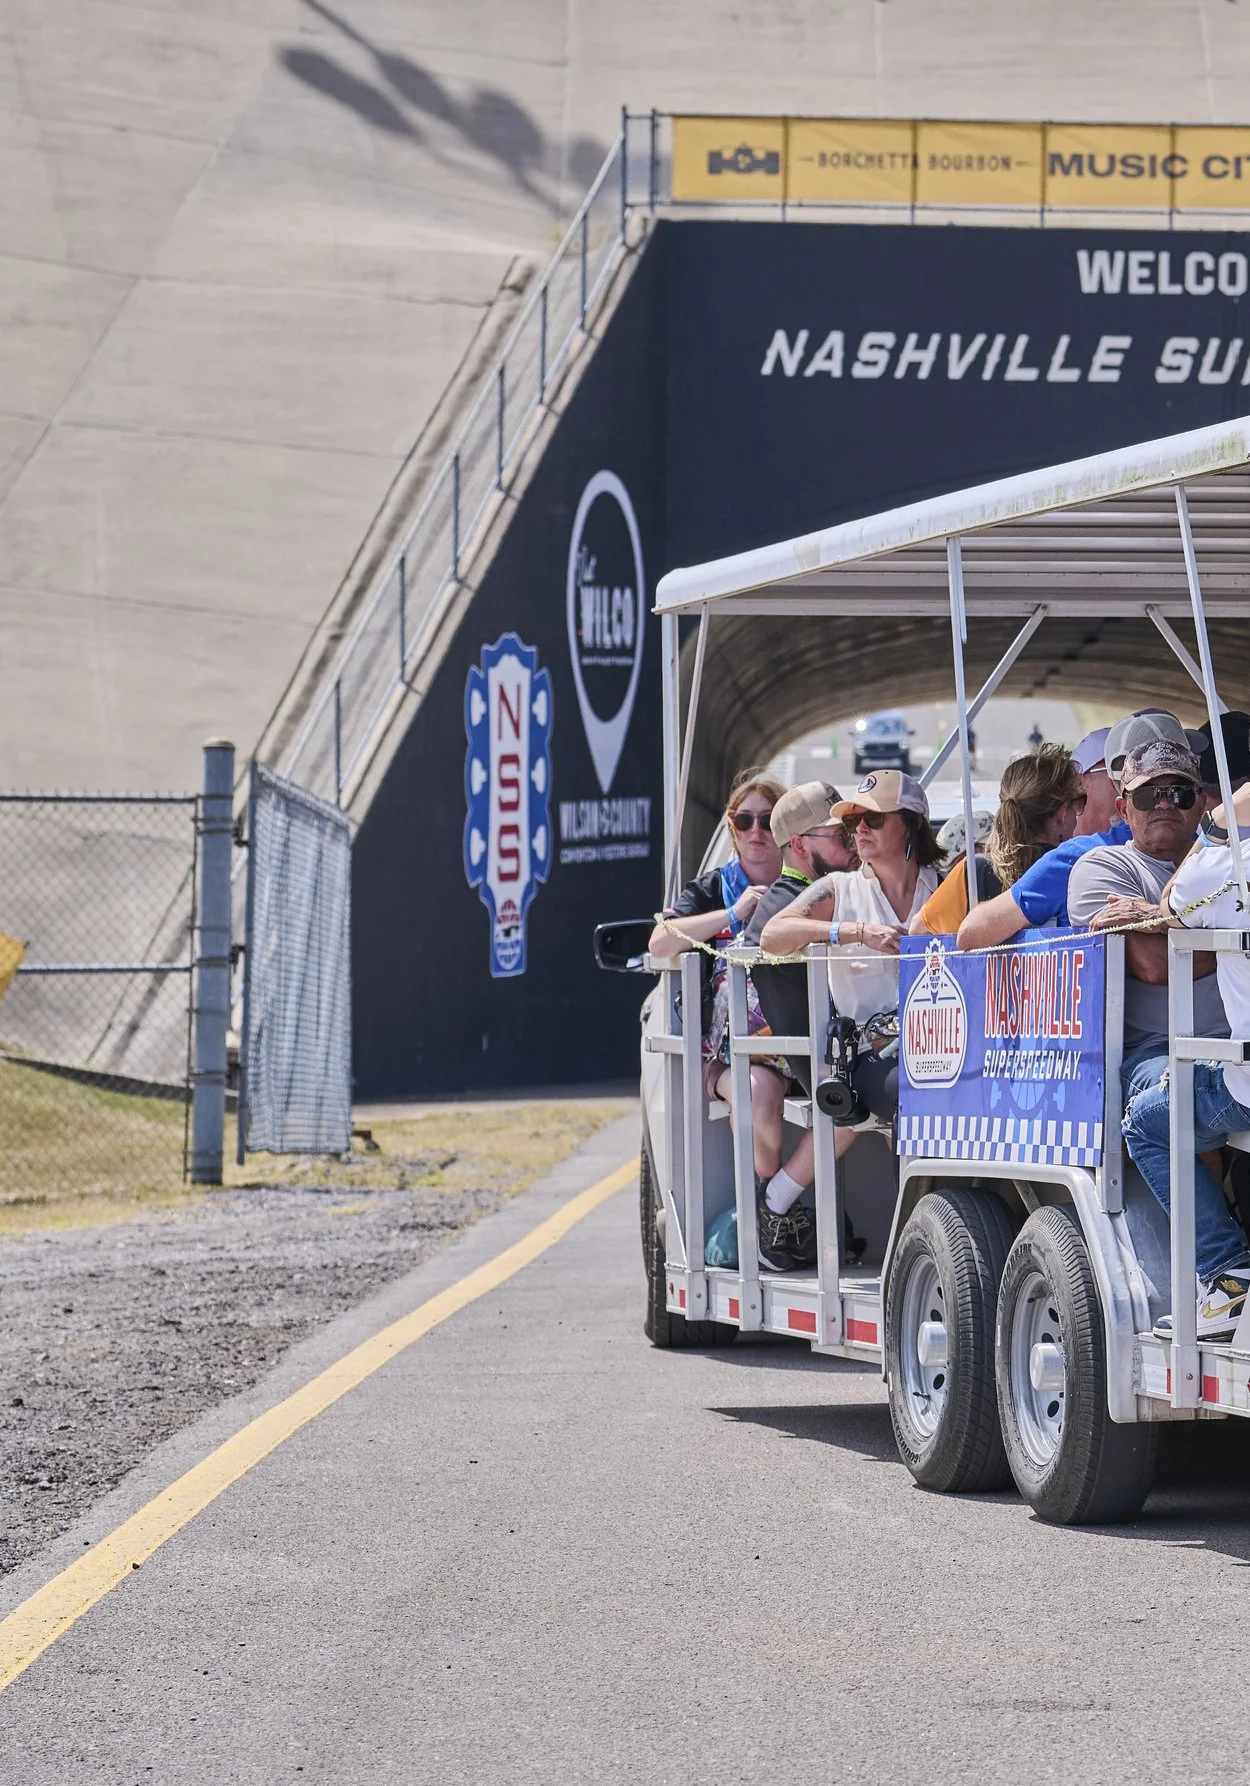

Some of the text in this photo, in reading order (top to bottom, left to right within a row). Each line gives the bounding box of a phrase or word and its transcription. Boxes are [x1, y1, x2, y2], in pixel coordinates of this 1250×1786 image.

[817, 151, 1013, 172] BORCHETTA BOURBON
[1047, 153, 1188, 180] MUSIC
[761, 329, 1132, 382] NASHVILLE
[580, 586, 634, 649] WILCO
[983, 950, 1084, 1039] NASHVILLE
[907, 1006, 962, 1056] NASHVILLE
[982, 1050, 1082, 1081] SUPERSPEEDWAY
